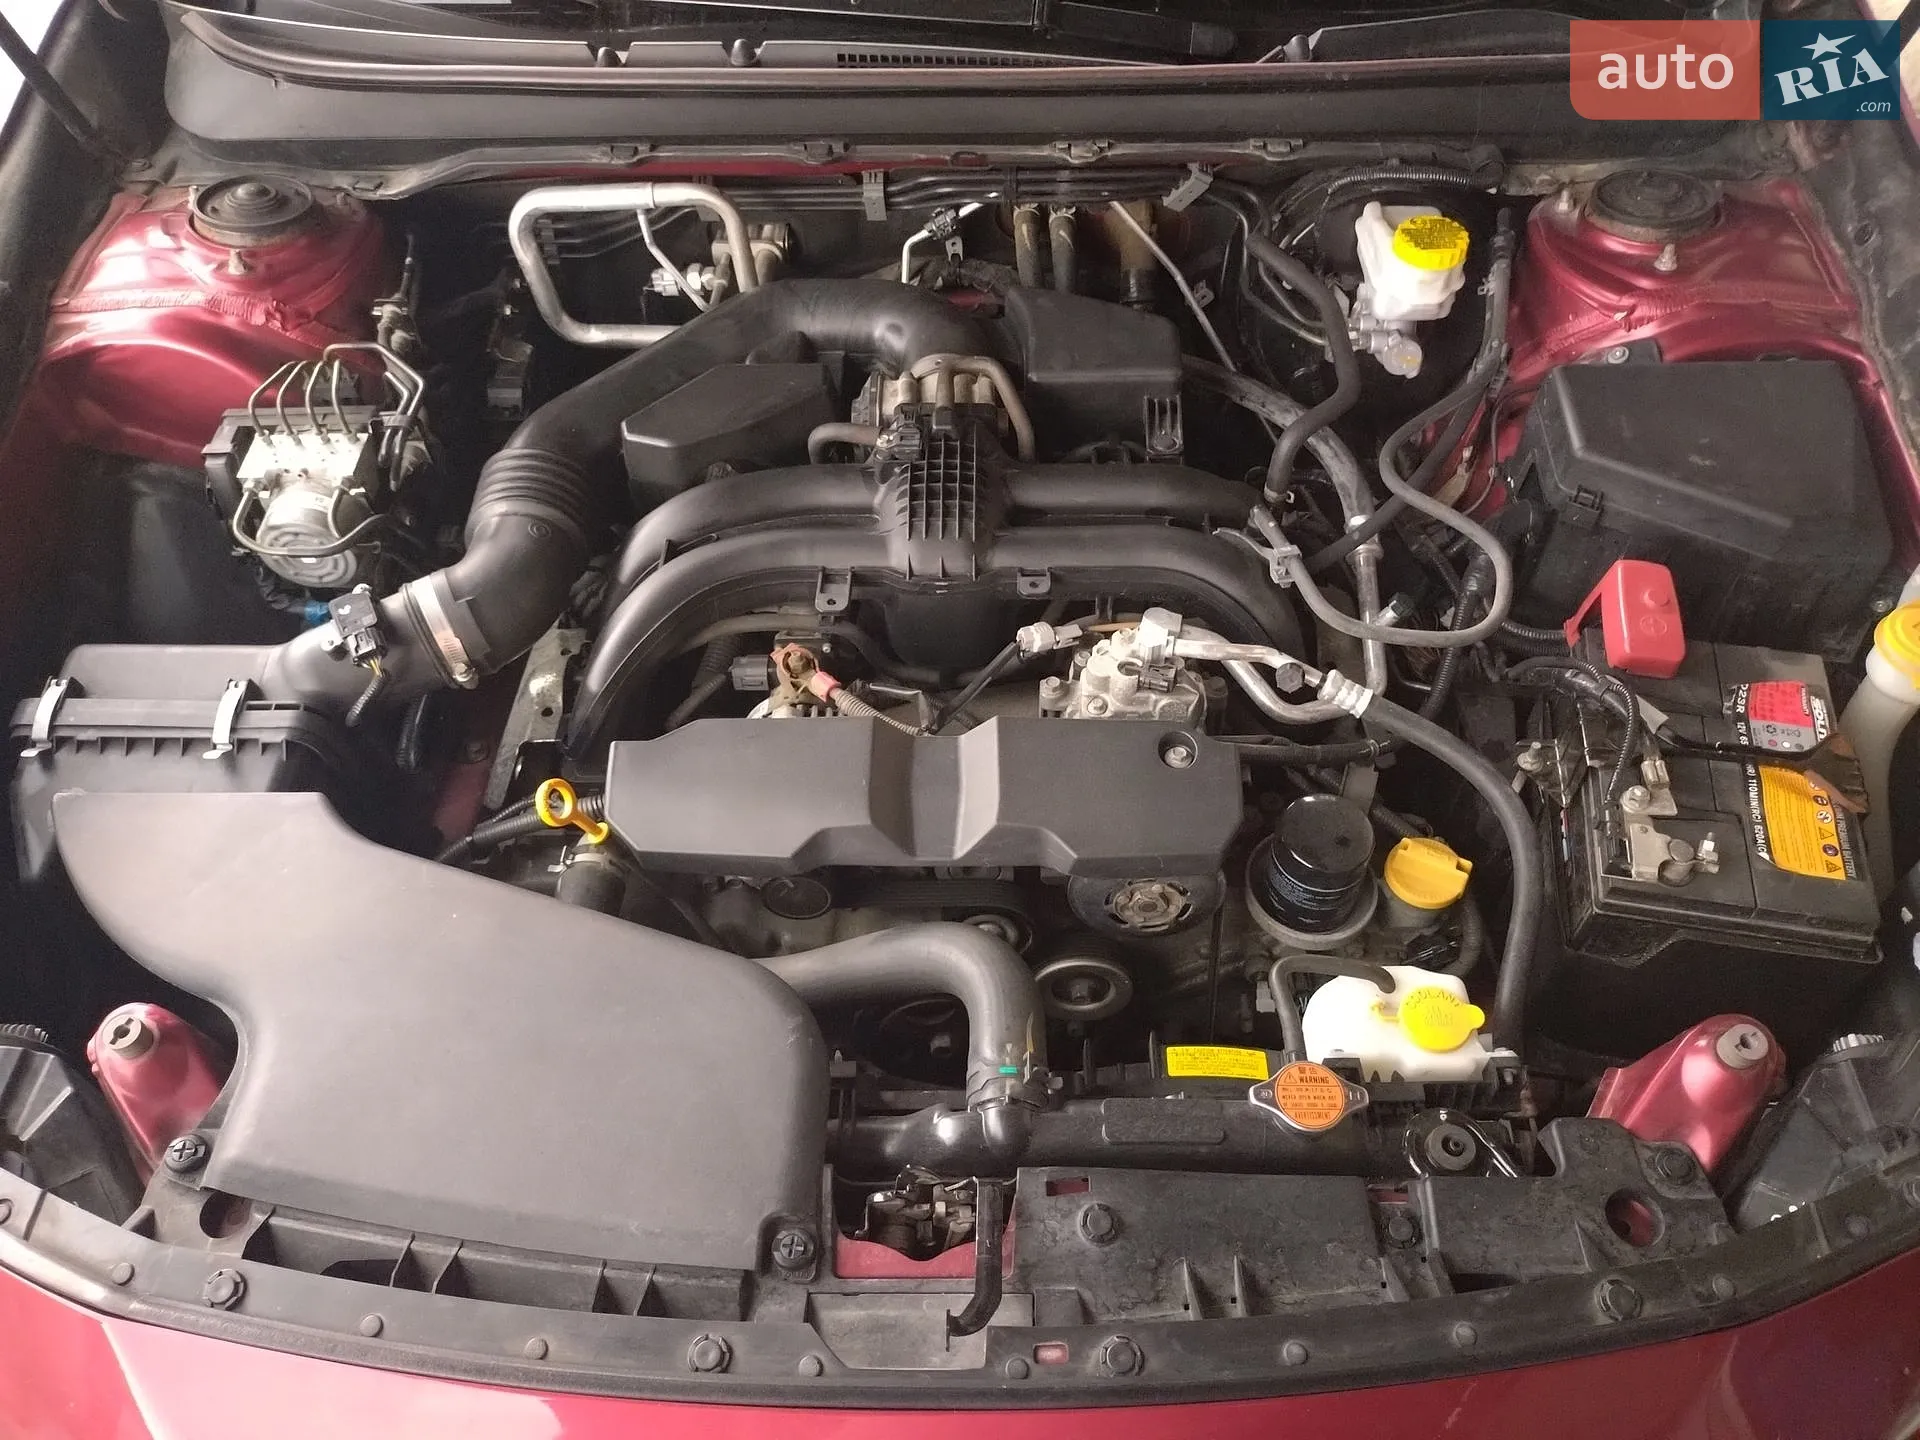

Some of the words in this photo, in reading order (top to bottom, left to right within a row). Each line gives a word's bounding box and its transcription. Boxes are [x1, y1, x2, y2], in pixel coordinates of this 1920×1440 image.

[1748, 779, 1763, 823] 110MIN(RC)
[1842, 850, 1857, 880] BATTERY
[1298, 1076, 1330, 1085] WARNING
